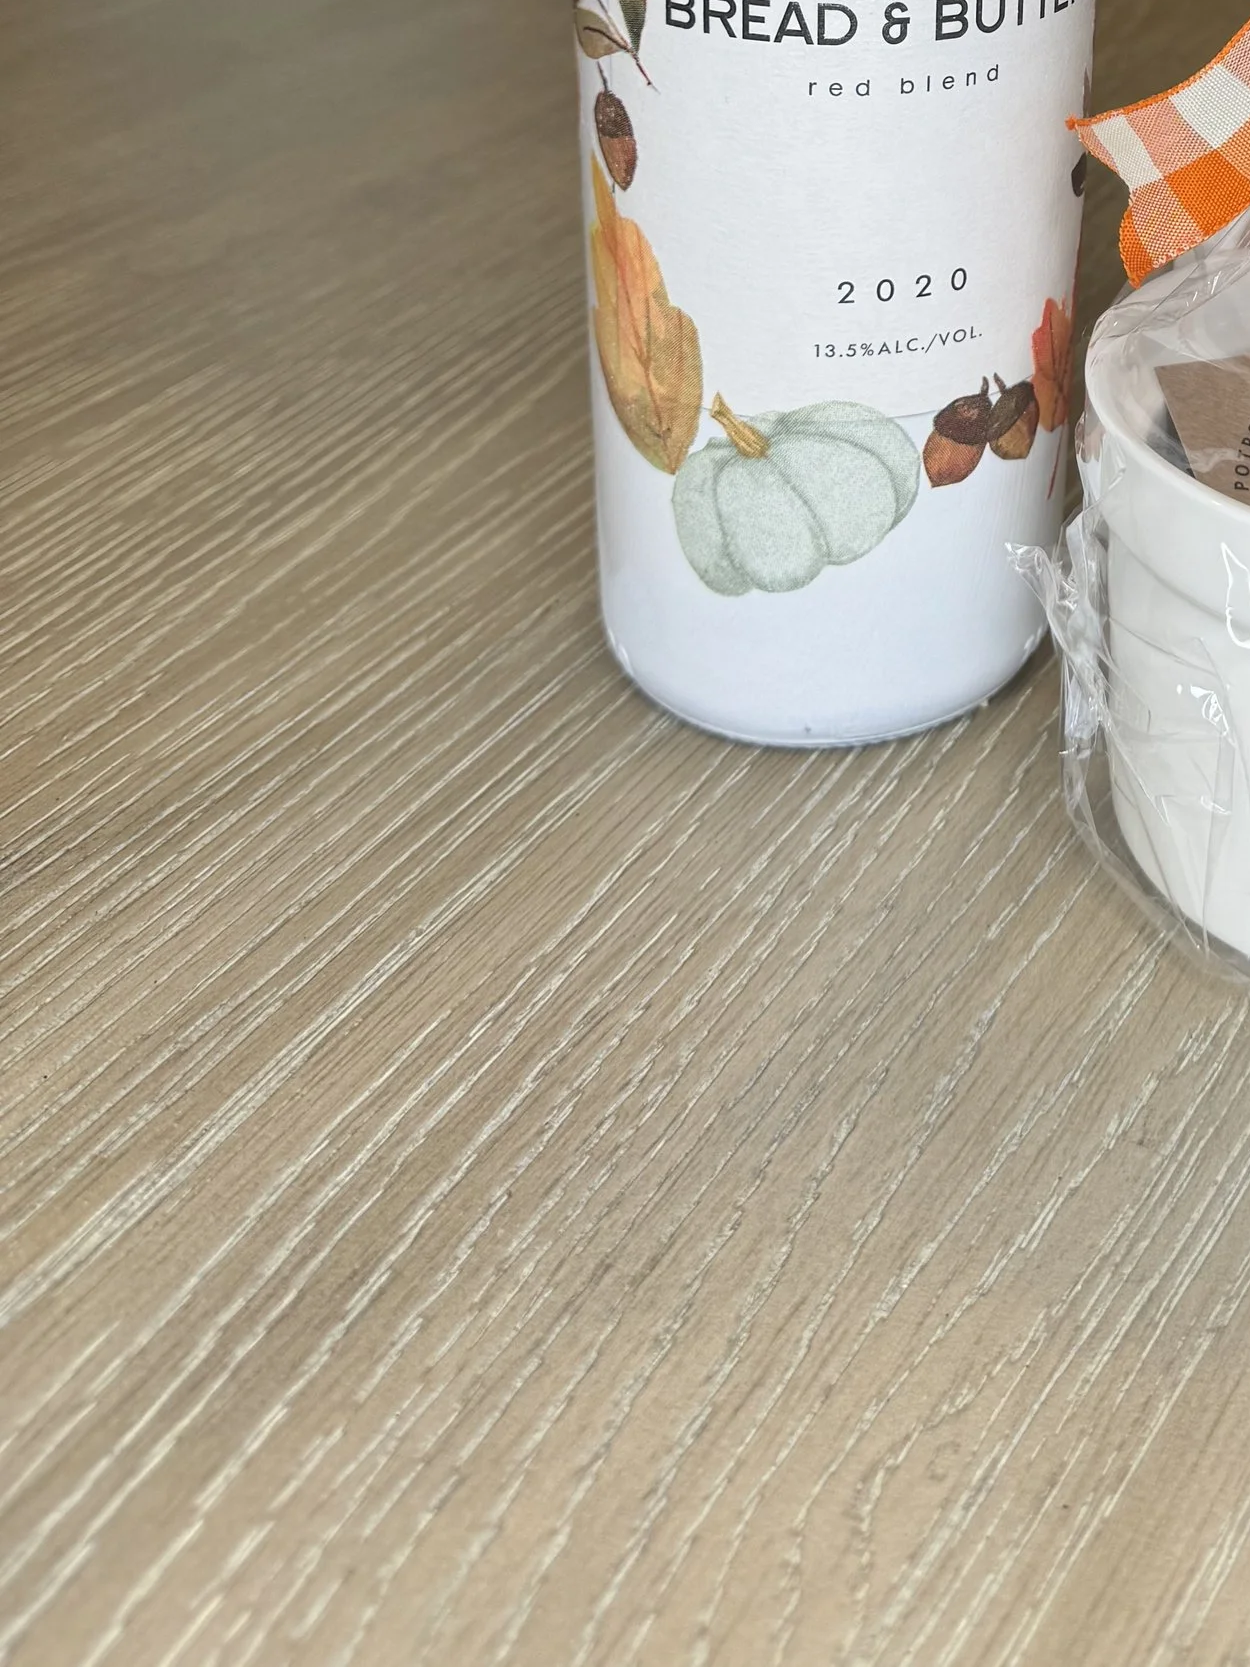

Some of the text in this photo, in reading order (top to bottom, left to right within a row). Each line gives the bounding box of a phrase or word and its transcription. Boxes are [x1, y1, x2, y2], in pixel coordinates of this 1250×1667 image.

[881, 1, 911, 45] &
[807, 64, 1000, 98] red blend
[836, 267, 969, 305] 2020
